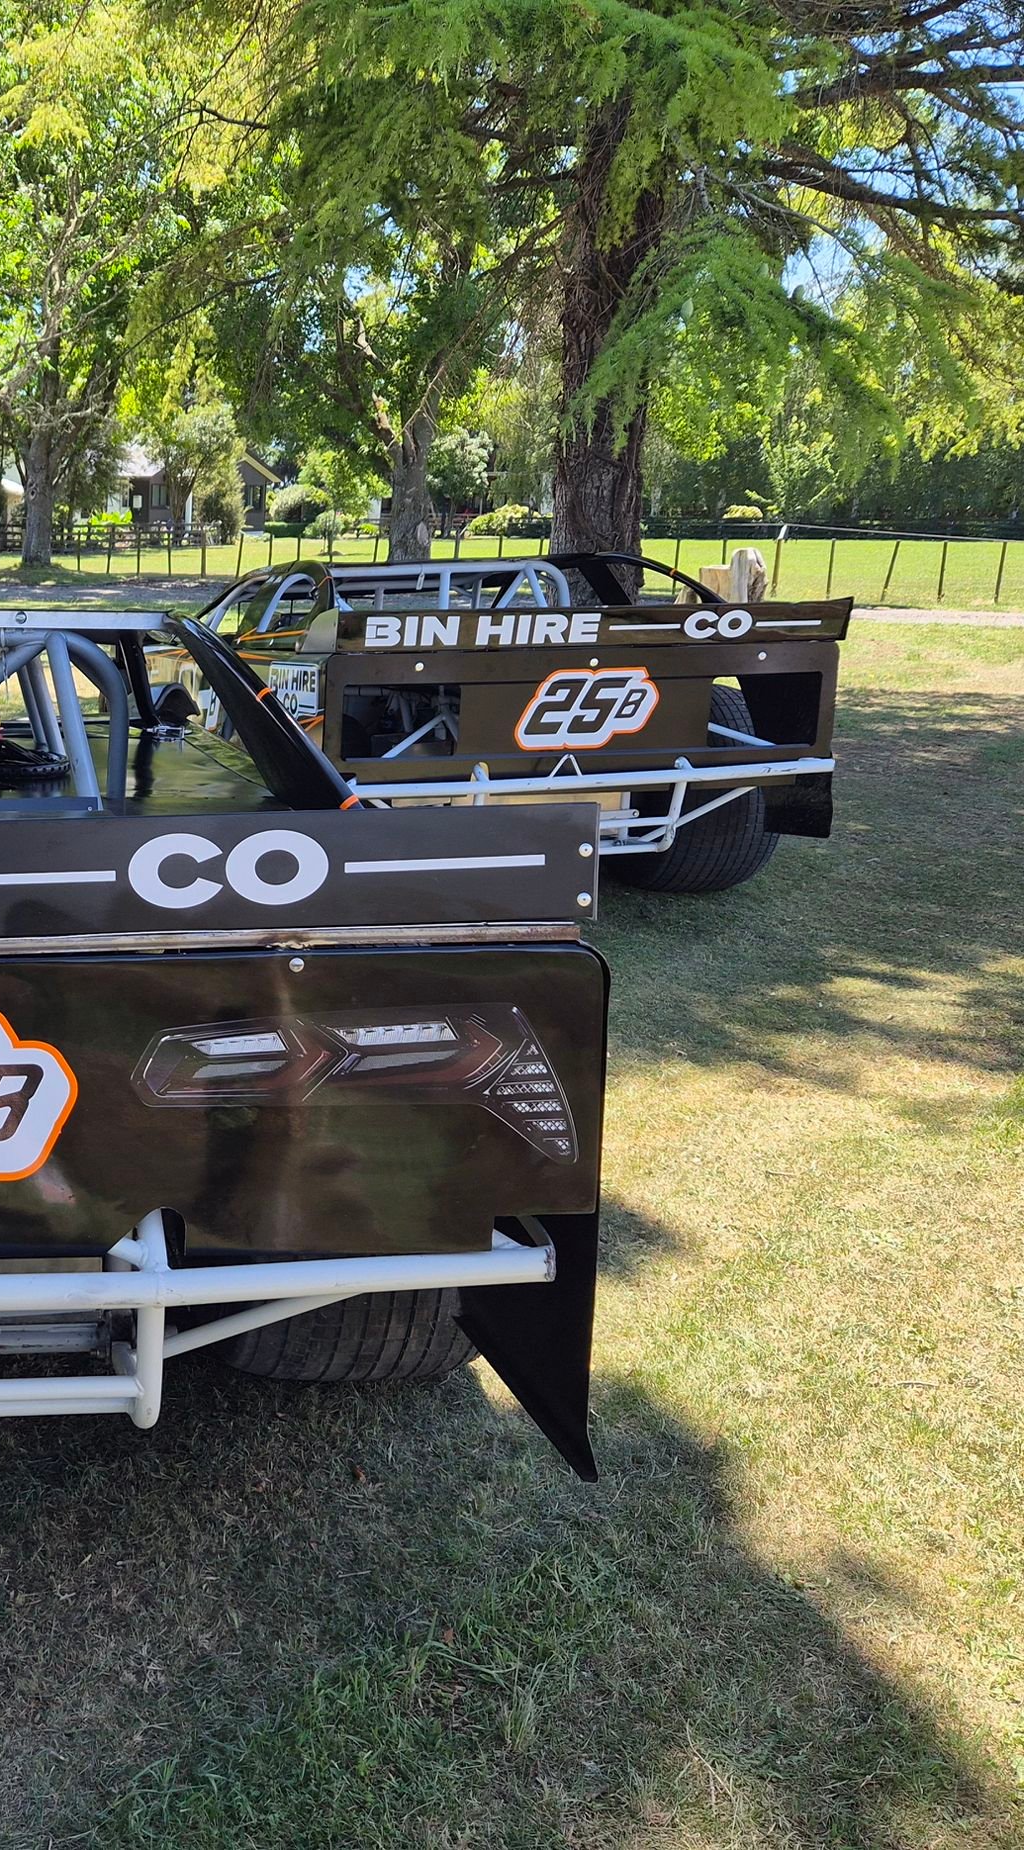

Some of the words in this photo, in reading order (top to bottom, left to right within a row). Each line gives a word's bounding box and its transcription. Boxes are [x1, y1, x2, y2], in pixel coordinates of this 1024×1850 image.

[365, 615, 460, 647] BIN
[475, 613, 602, 646] HIRE
[683, 610, 753, 639] CO
[291, 669, 316, 692] HIRE
[283, 692, 298, 715] CO
[128, 829, 330, 909] CO
